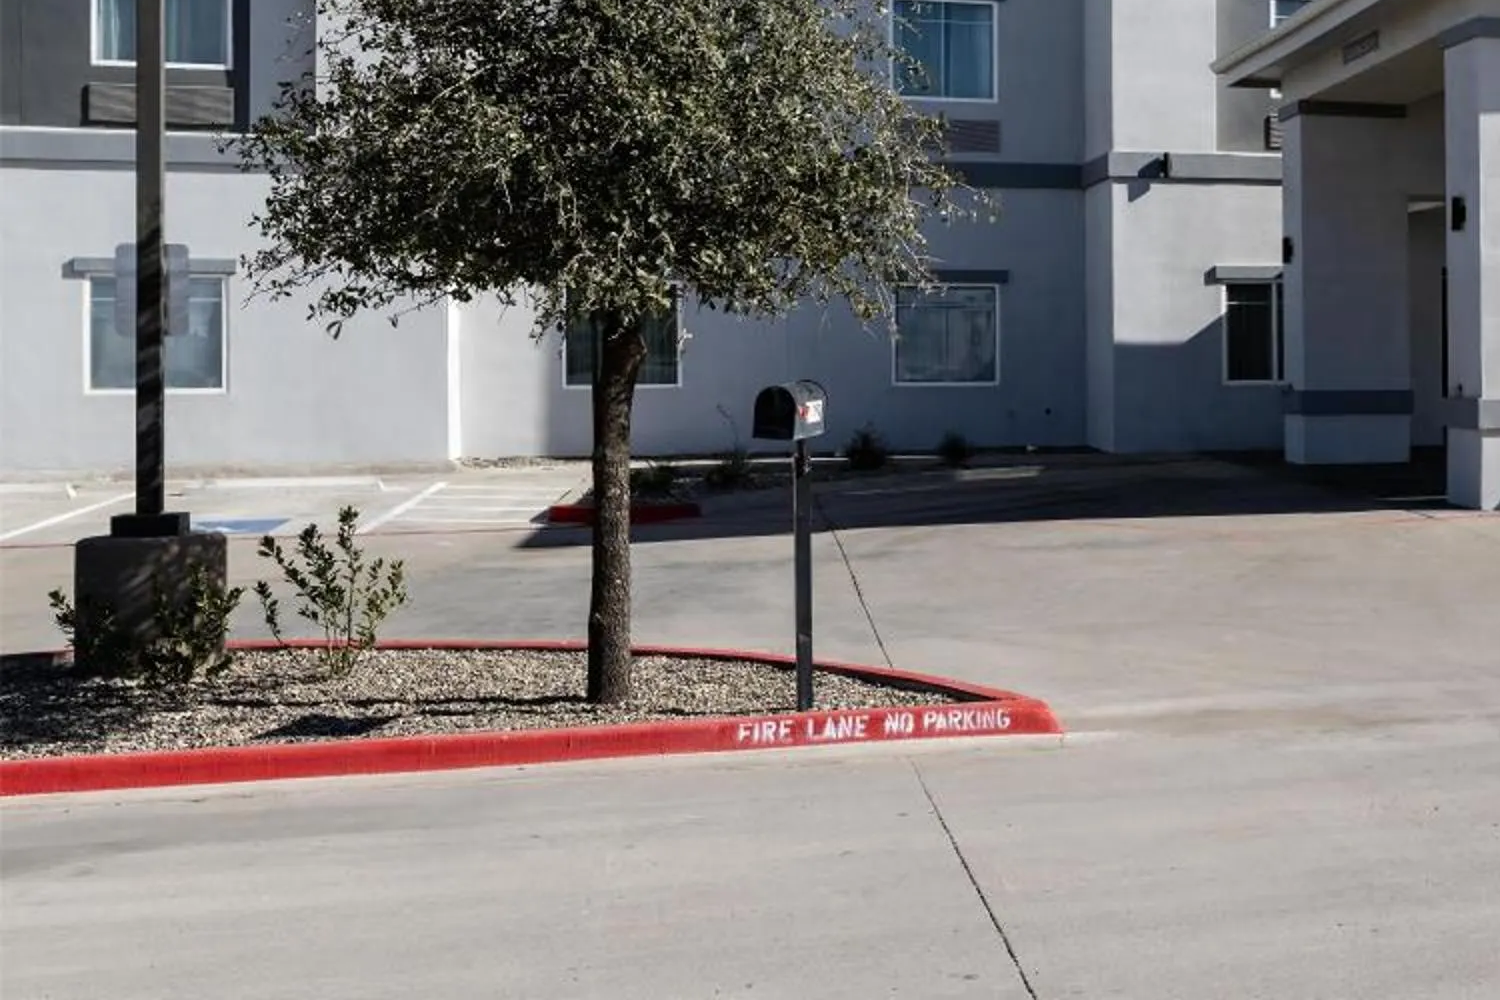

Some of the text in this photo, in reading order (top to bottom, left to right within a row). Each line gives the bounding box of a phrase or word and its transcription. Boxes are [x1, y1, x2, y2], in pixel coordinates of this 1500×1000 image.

[737, 708, 1011, 744] FIRE LANE NO PARKING
